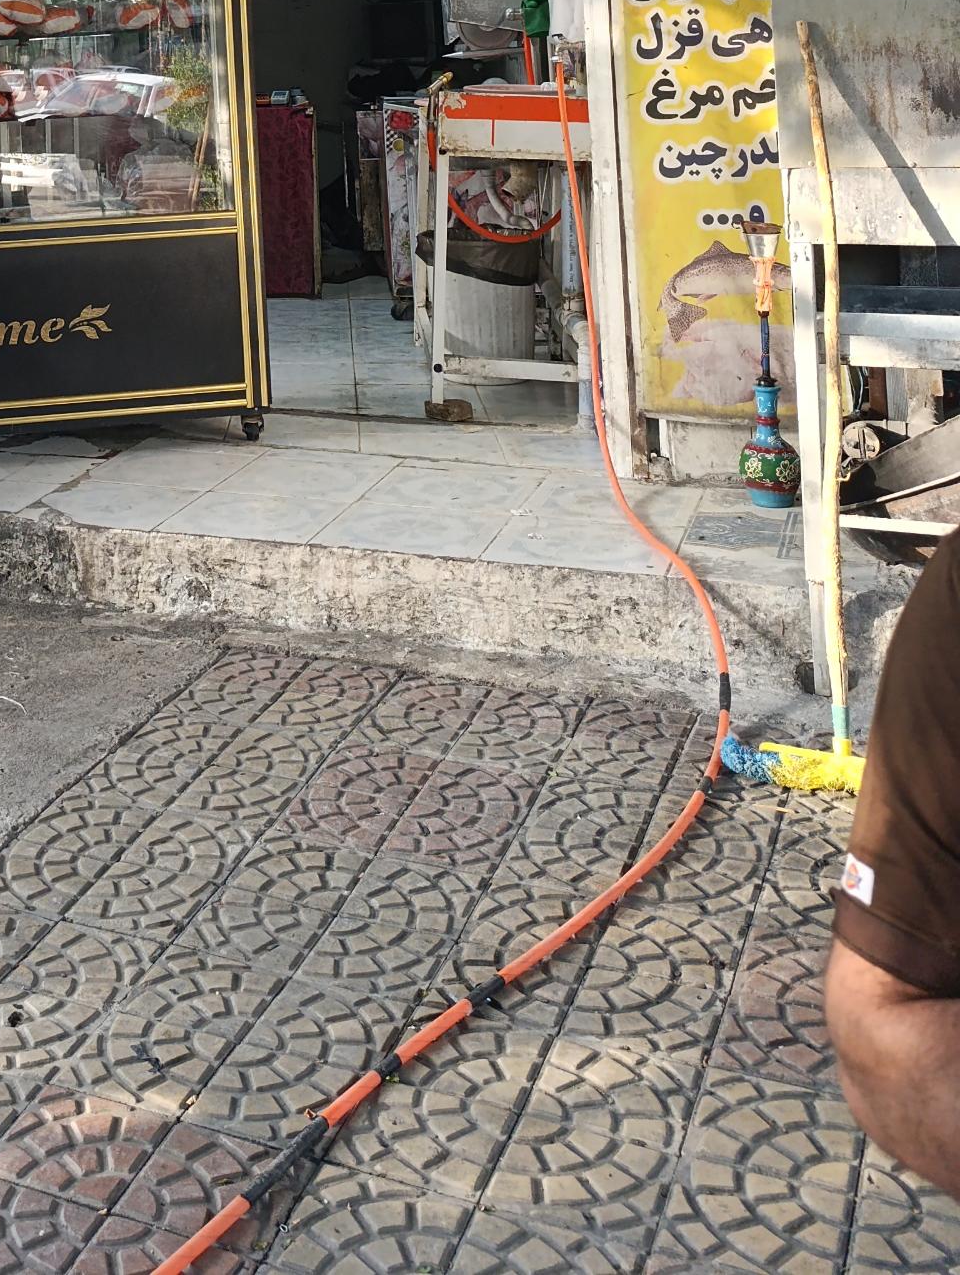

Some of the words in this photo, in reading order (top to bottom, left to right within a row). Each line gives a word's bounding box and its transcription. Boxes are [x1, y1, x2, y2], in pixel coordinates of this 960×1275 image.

[635, 8, 704, 60] قزل
[645, 68, 725, 120] مرغ
[732, 67, 776, 118] خم
